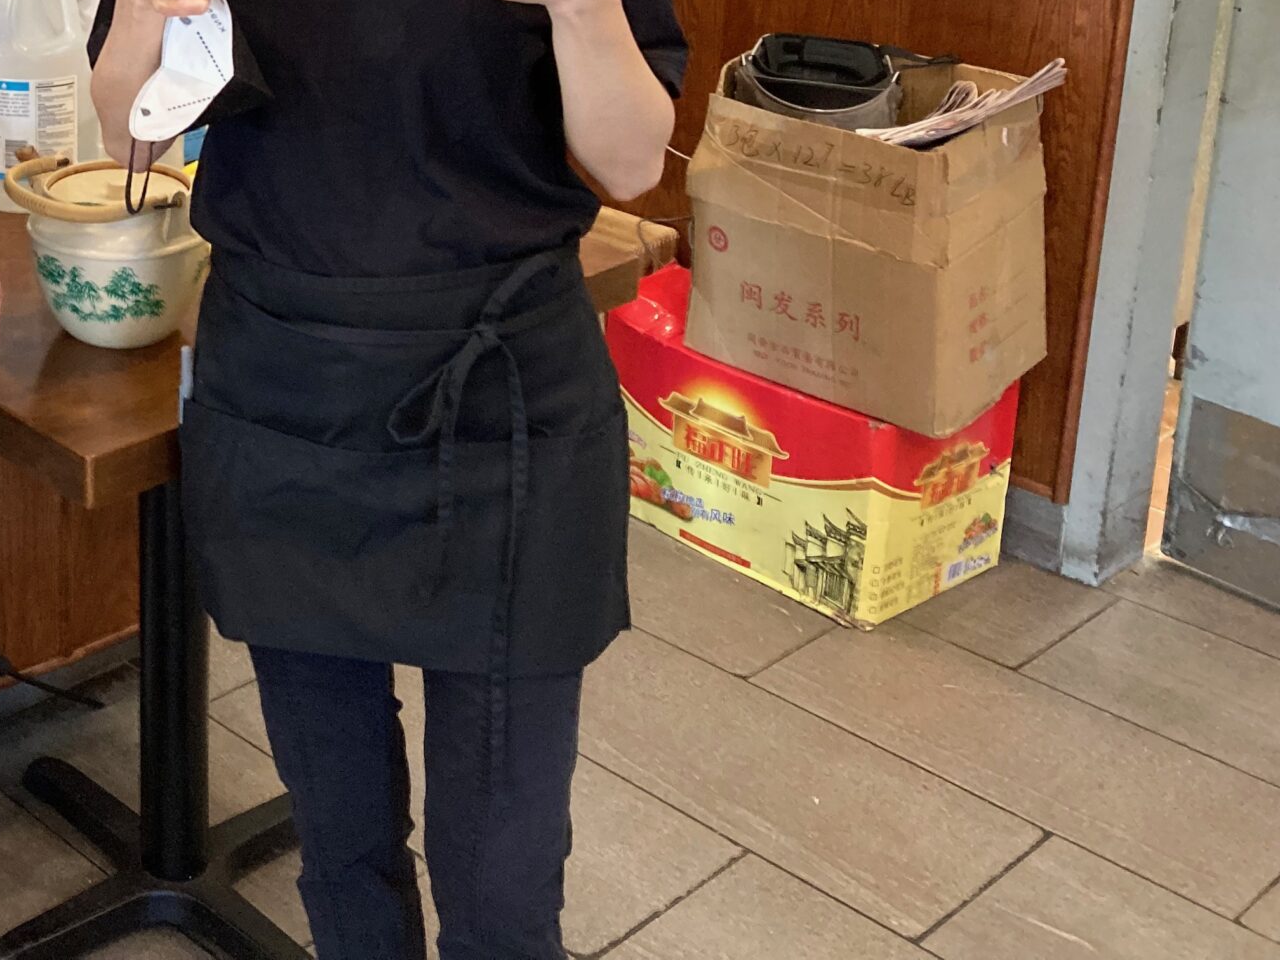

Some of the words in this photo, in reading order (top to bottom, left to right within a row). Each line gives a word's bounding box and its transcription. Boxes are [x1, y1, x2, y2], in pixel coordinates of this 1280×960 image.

[740, 280, 861, 343] 闽发系列
[735, 478, 763, 496] WANG
